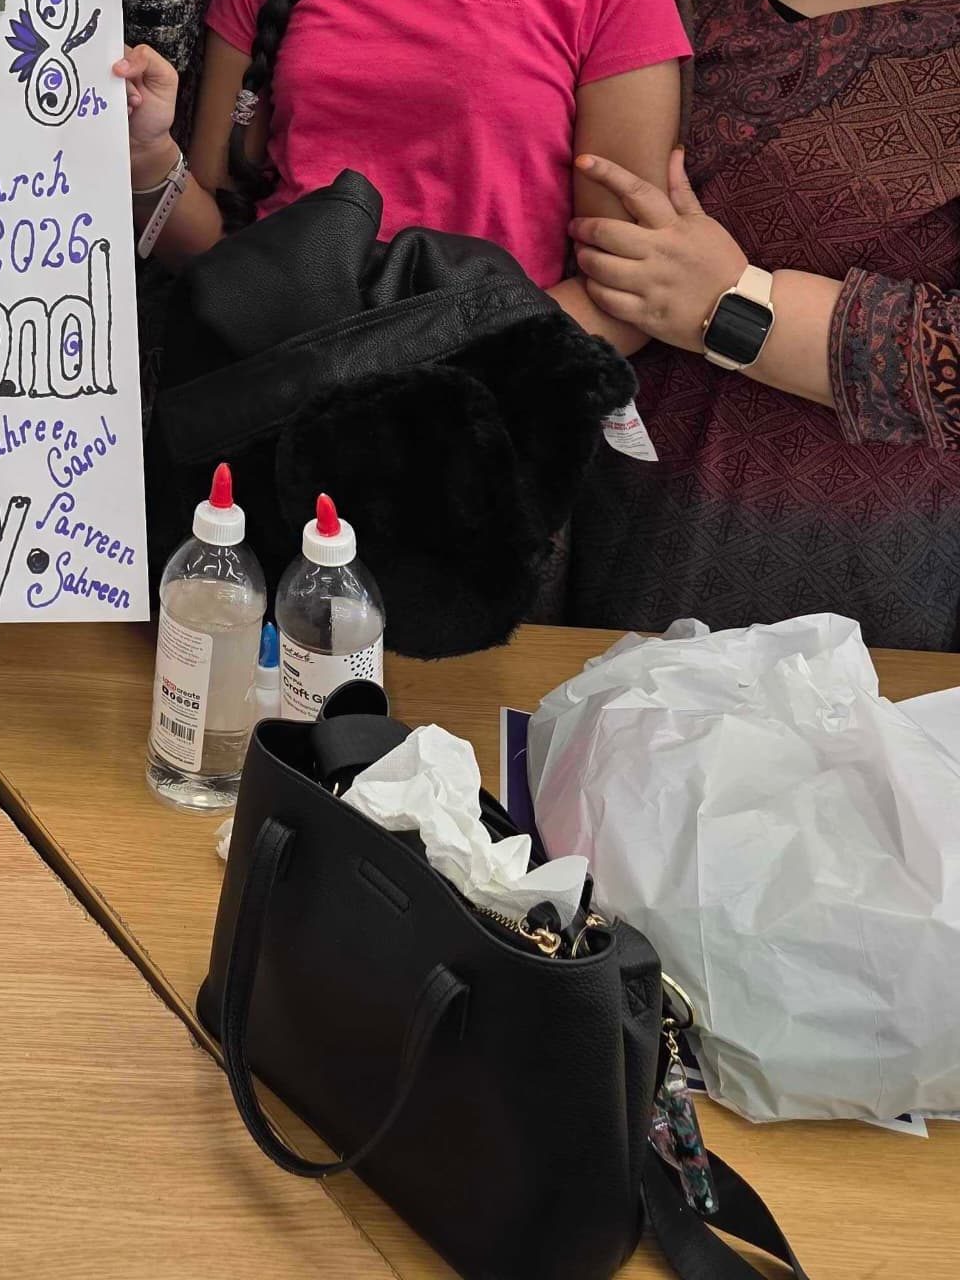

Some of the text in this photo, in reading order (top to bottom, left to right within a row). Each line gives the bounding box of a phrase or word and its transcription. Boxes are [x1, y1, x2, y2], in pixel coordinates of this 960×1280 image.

[46, 415, 117, 489] Carol
[35, 491, 136, 566] Parveen
[26, 550, 131, 609] Sahreen
[283, 676, 327, 705] Craft Gl
